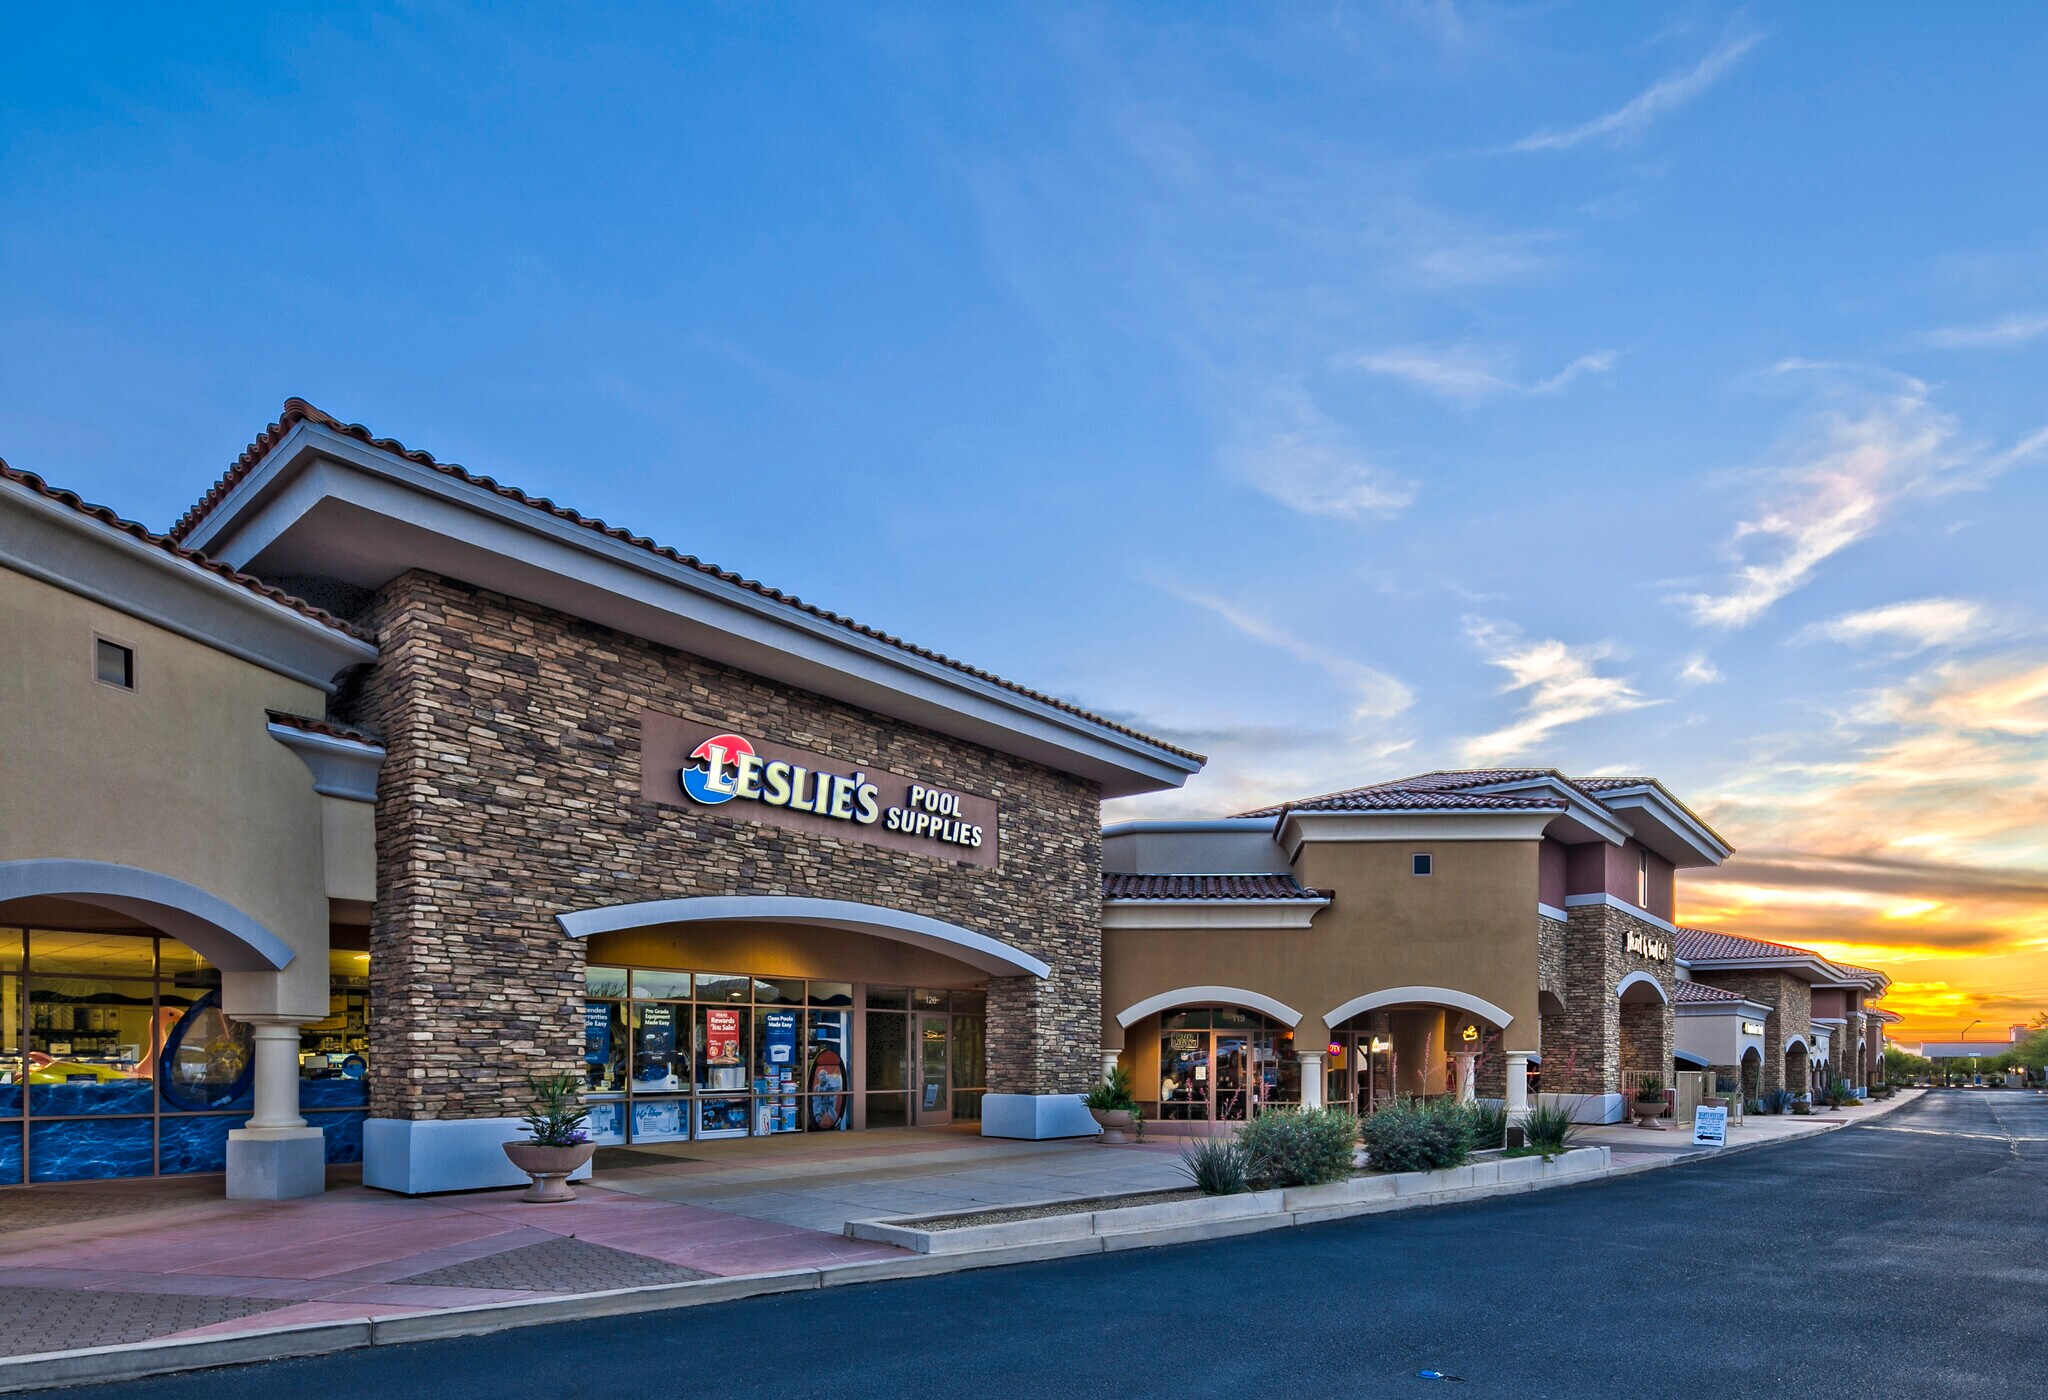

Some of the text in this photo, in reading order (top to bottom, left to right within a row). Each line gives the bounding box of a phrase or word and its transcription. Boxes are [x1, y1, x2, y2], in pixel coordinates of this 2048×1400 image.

[704, 744, 879, 824] LESLIE'S
[909, 784, 962, 818] POOL
[886, 806, 983, 847] SUPPLIES
[594, 1020, 608, 1028] Easy
[781, 1021, 793, 1029] Easy
[1232, 1014, 1246, 1023] 119
